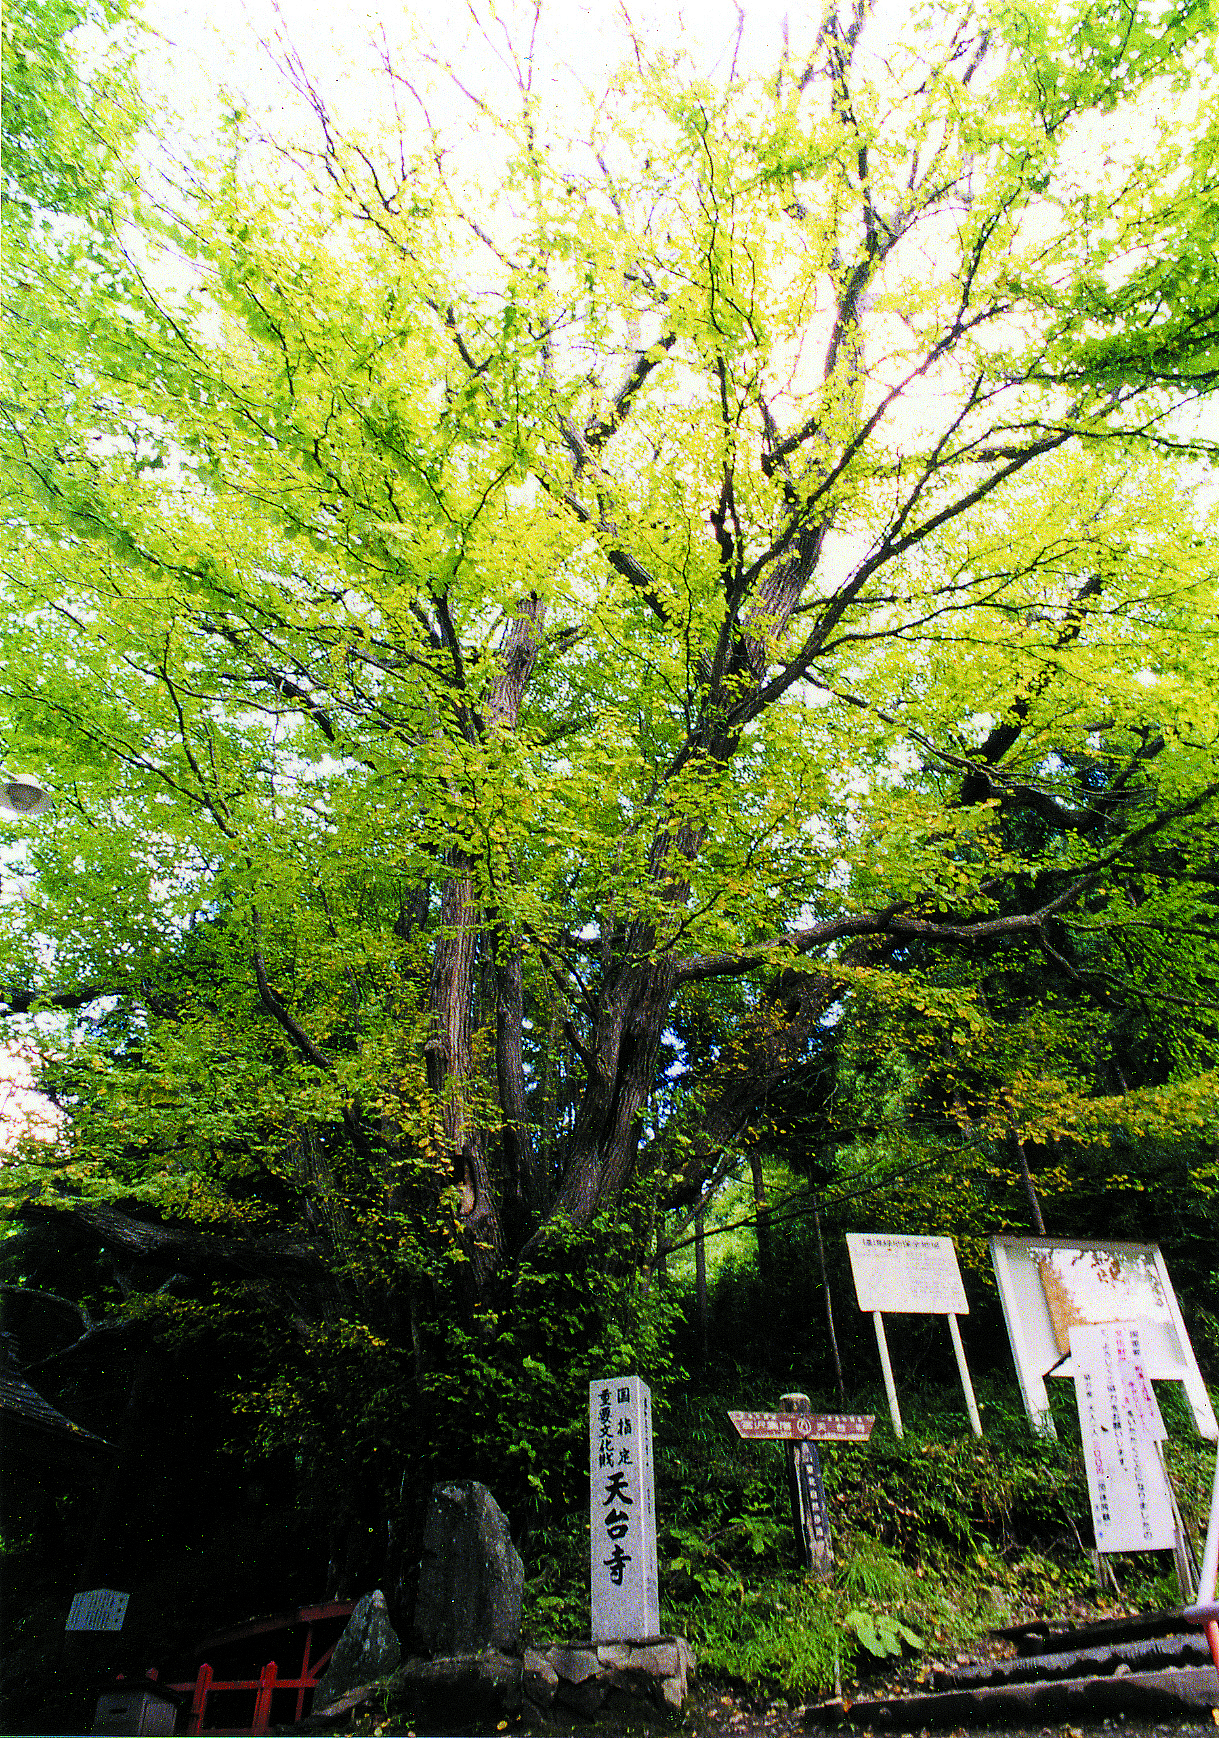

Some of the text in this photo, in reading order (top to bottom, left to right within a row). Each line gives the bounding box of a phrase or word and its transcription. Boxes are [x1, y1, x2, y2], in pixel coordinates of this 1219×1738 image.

[598, 1388, 615, 1468] 重要文化財
[617, 1387, 633, 1466] 国指定
[603, 1470, 634, 1586] 天台寺
